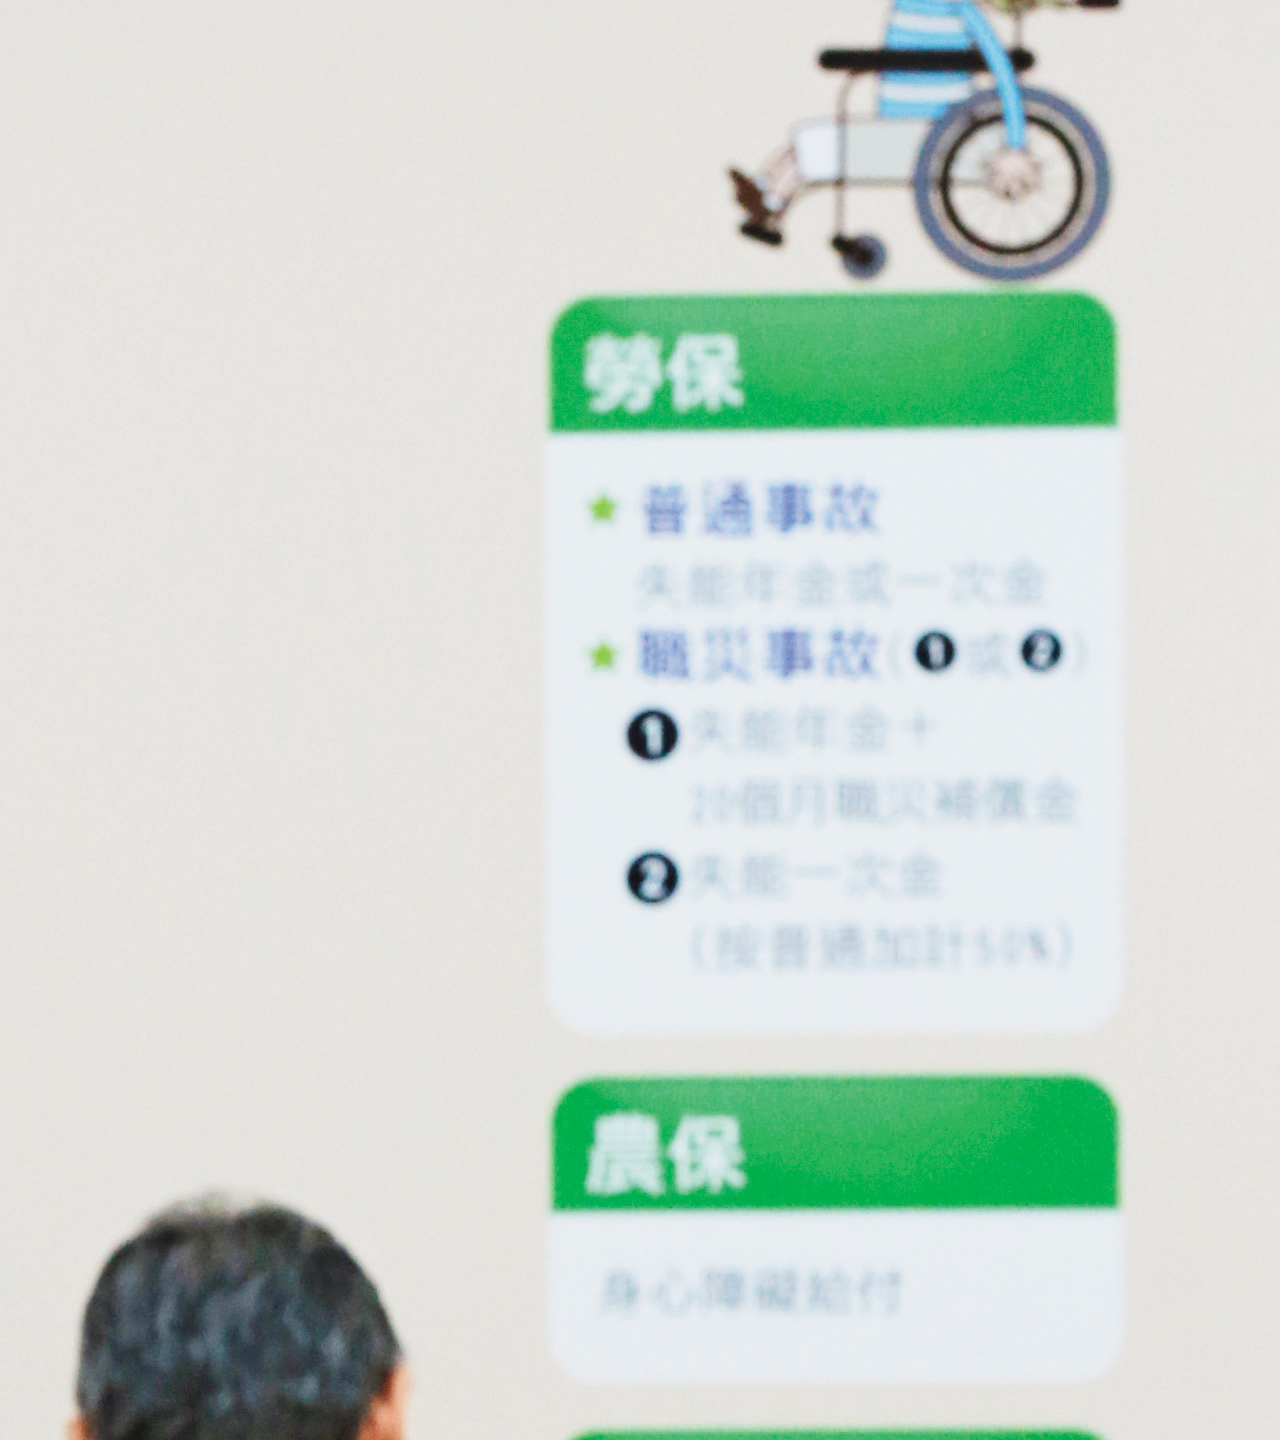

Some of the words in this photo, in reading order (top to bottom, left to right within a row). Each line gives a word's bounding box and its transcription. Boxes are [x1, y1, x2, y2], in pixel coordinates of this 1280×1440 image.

[583, 333, 745, 413] 勞保
[642, 480, 880, 538] 普通事故
[584, 1113, 747, 1197] 農保
